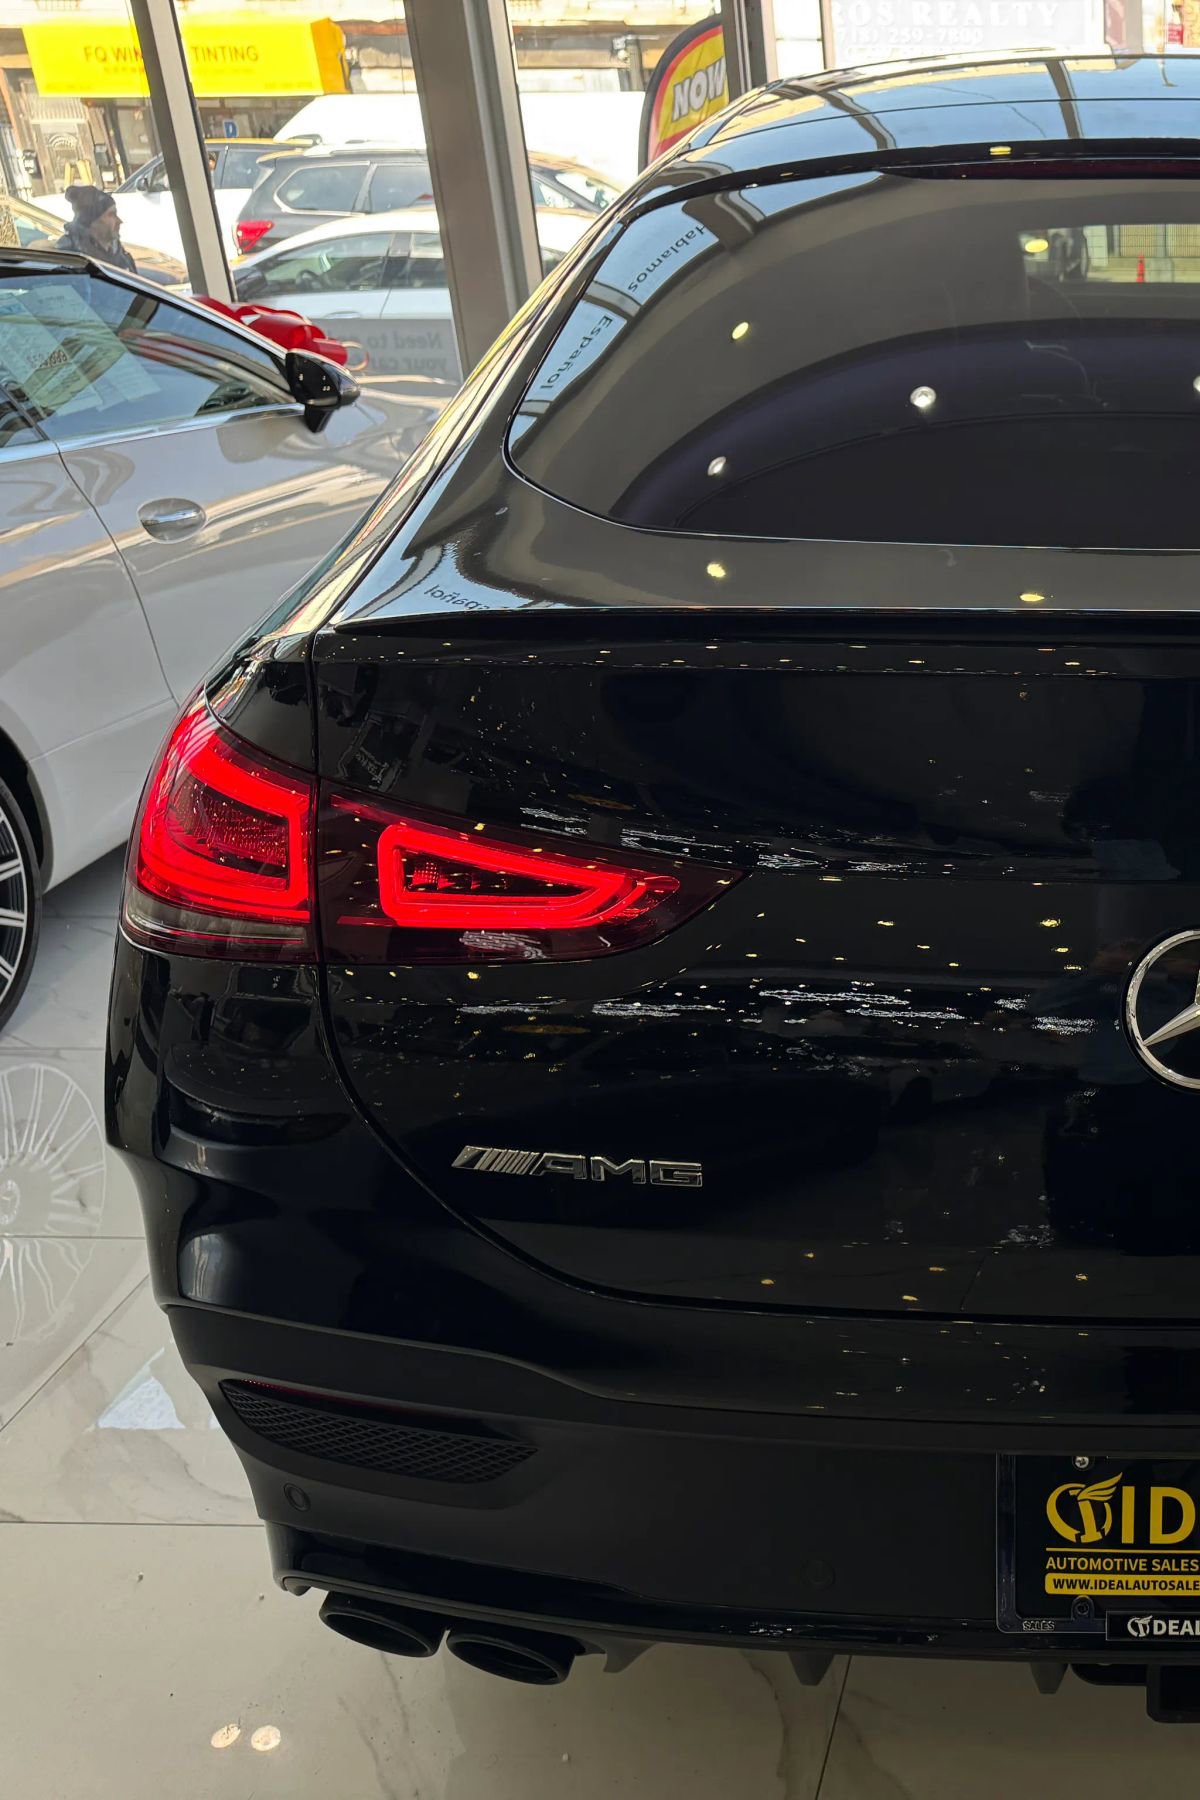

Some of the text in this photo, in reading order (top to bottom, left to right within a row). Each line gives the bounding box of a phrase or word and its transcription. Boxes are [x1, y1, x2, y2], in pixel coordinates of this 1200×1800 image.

[911, 0, 1059, 27] REALTY
[190, 45, 260, 63] TINTING
[671, 55, 727, 122] NOW
[1045, 1556, 1148, 1572] AUTOMOTIVE
[1151, 1558, 1200, 1573] SALES
